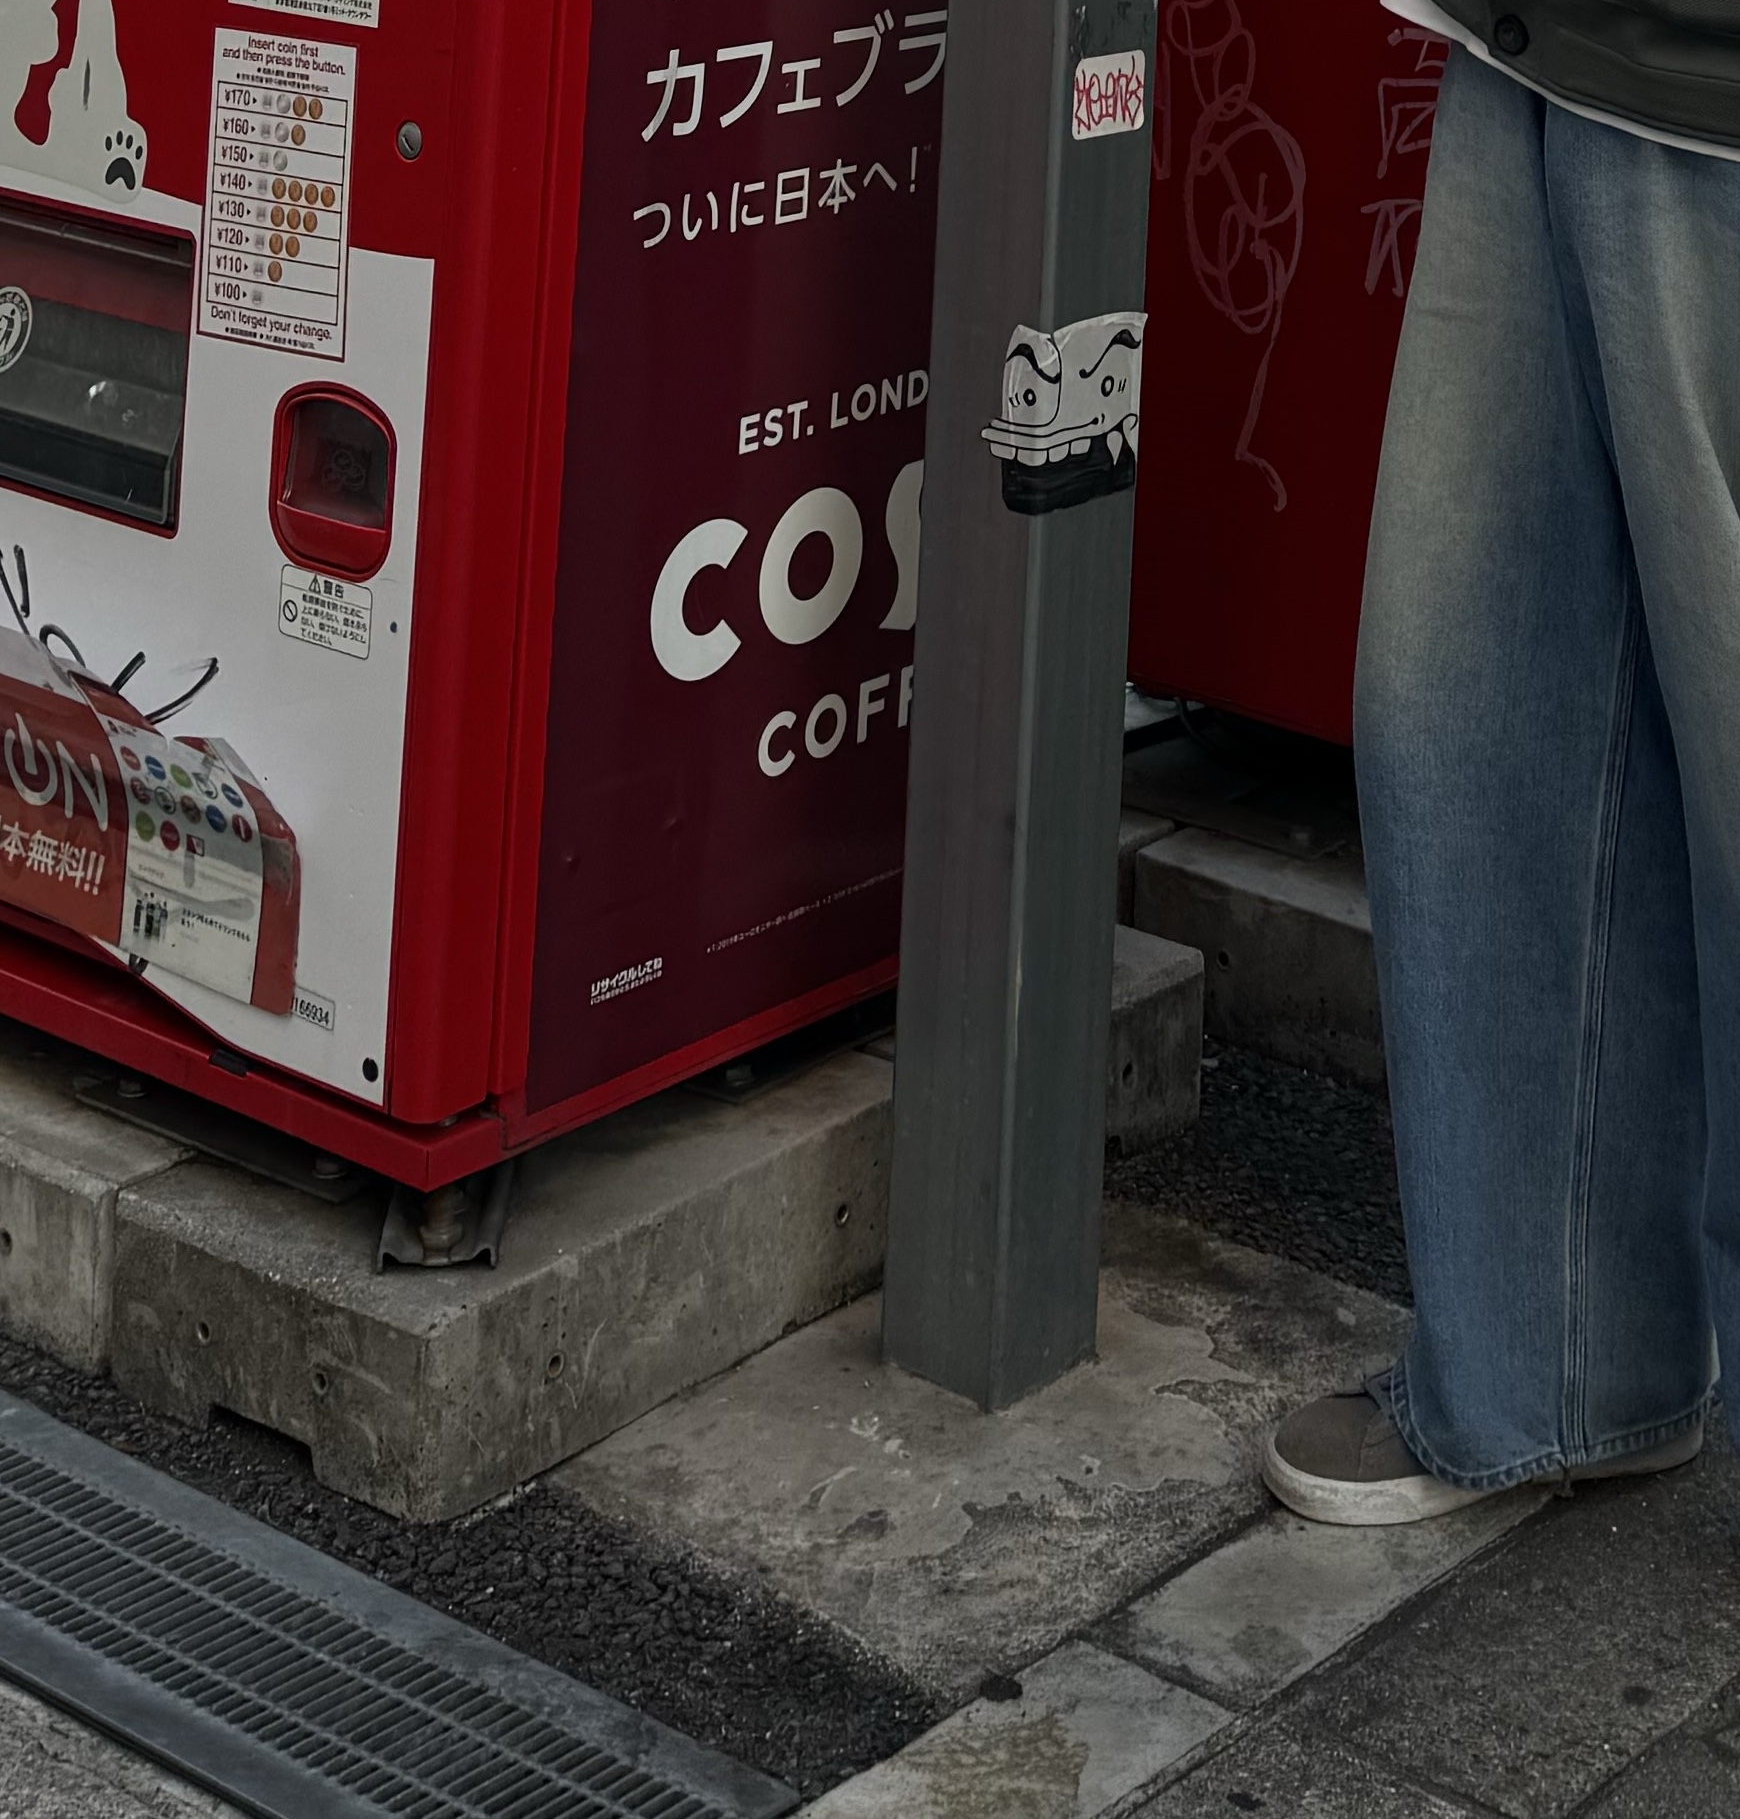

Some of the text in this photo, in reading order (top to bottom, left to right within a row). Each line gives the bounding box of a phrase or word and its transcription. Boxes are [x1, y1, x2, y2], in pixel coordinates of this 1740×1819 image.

[248, 34, 319, 59] Insert coin first
[222, 47, 241, 60] and
[243, 49, 264, 63] then
[266, 55, 294, 72] press
[295, 56, 310, 70] the
[641, 9, 949, 143] カフェブラ
[224, 88, 251, 107] ¥170
[222, 117, 249, 136] ¥160
[221, 144, 248, 163] ¥150
[219, 172, 246, 191] ¥140
[633, 146, 919, 249] ついに日本へ!
[218, 199, 245, 218] ¥130
[217, 227, 243, 246] ¥120
[216, 254, 242, 273] ¥110
[214, 281, 241, 301] ¥100
[211, 305, 237, 322] Don't
[239, 311, 268, 331] forget
[269, 318, 292, 335] your
[738, 369, 930, 456] EST. LOND
[591, 956, 663, 998] リサイクルしてね
